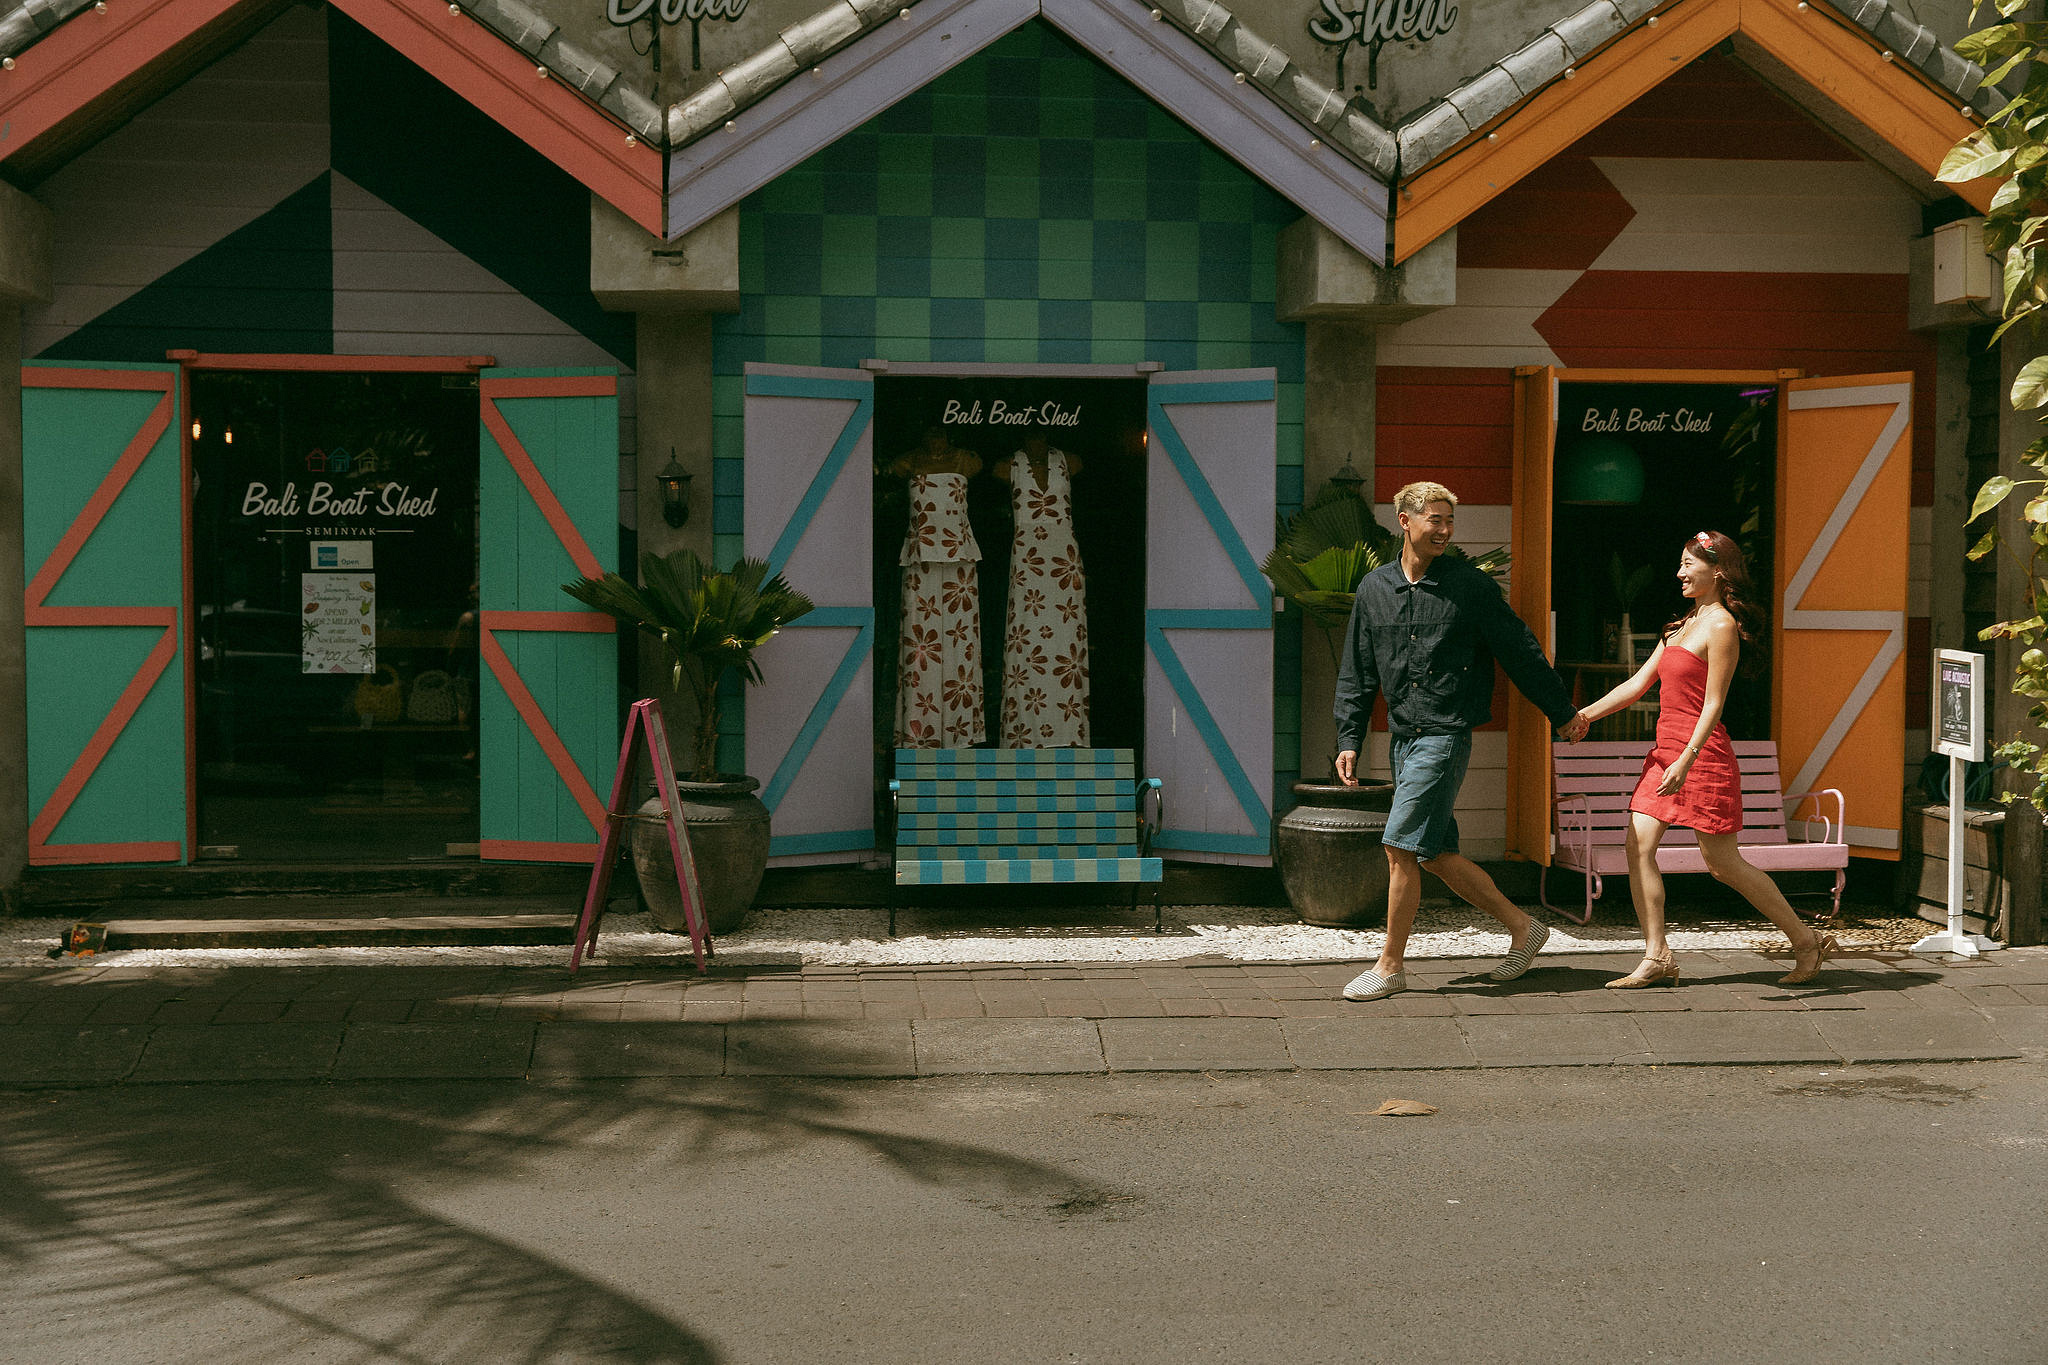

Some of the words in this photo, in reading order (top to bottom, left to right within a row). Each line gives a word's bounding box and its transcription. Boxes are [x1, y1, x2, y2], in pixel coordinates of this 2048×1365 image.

[942, 399, 983, 425] Bali
[988, 399, 1037, 425] Boat
[1037, 400, 1081, 426] Shed
[1582, 408, 1621, 432] Bali
[1625, 408, 1670, 432] Boat
[1671, 408, 1713, 432] Shed
[242, 482, 300, 516] Bali
[307, 482, 374, 516] Boat
[376, 482, 438, 517] Shed
[305, 527, 377, 536] SEMINYAK
[341, 558, 359, 566] Open
[324, 608, 348, 616] SPEND
[1943, 670, 1952, 682] LIVE
[1952, 671, 1971, 685] ACOUSTIC
